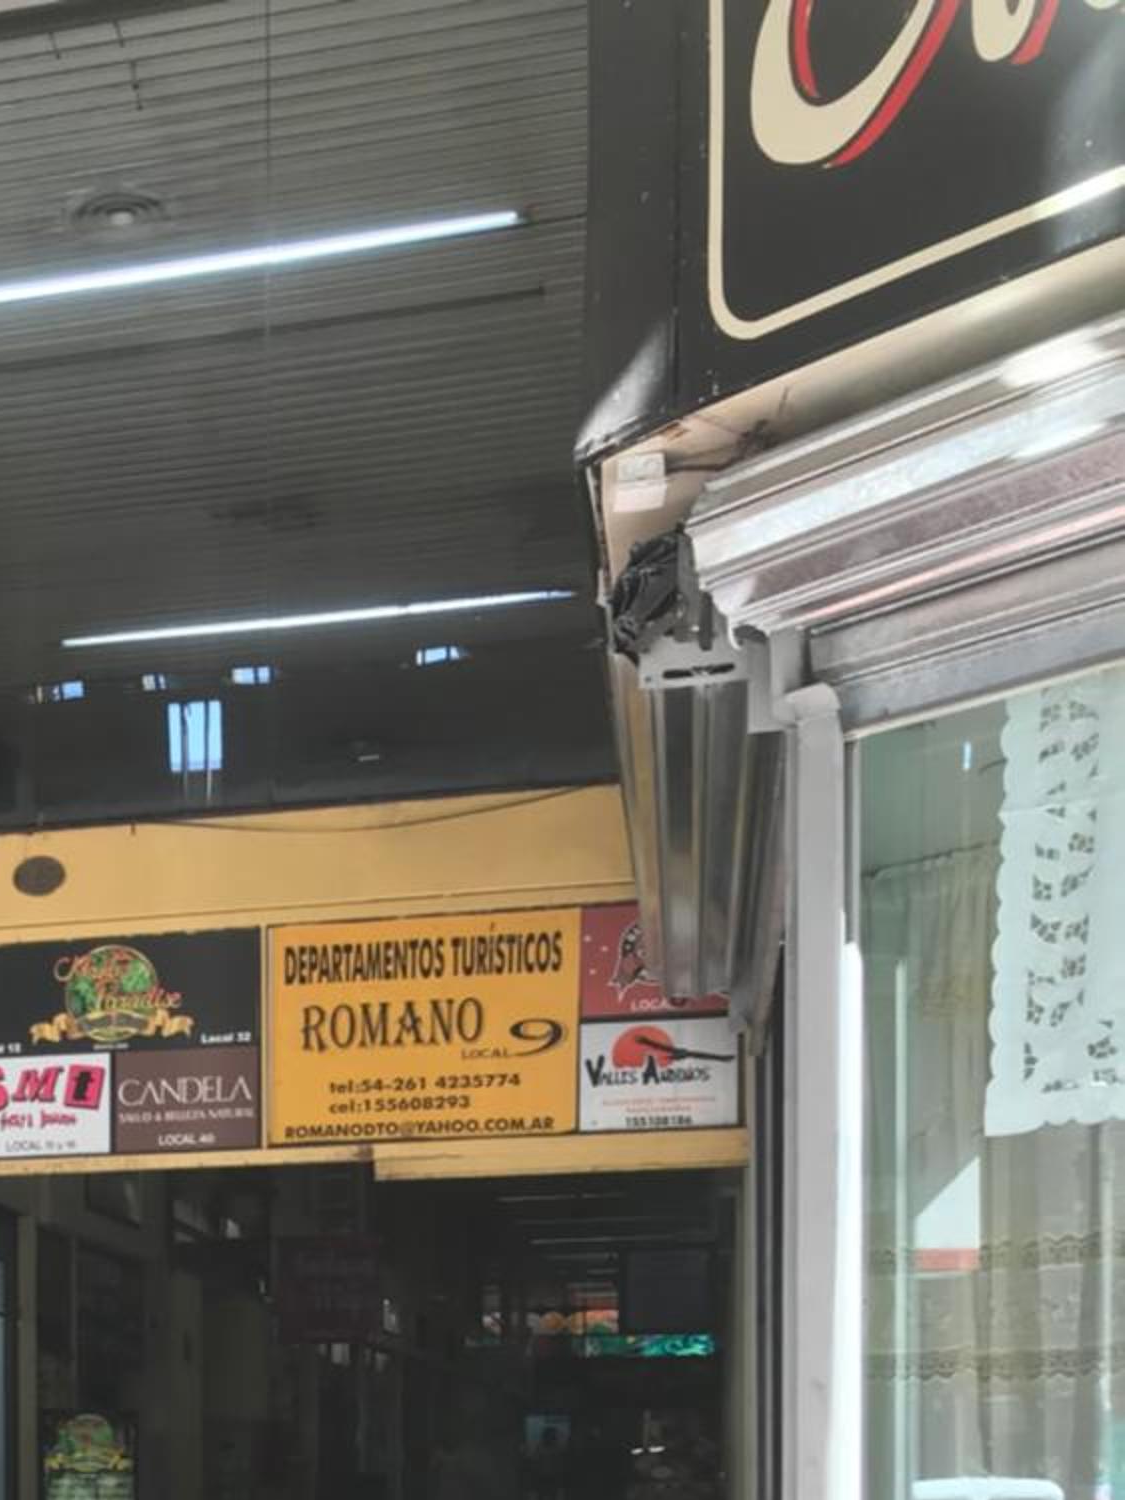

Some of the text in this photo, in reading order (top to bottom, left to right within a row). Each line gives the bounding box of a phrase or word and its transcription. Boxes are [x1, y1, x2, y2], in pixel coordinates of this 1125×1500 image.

[283, 937, 446, 987] DEPARTAMENTOS
[301, 996, 484, 1052] ROMANO
[460, 1017, 566, 1061] LOCAL 9
[117, 1075, 253, 1107] CANDELA
[328, 1073, 521, 1095] tel:54-261 4235774
[157, 1133, 197, 1147] LOCAL
[284, 1116, 556, 1139] ROMANODTO@YAHOO.COM.AR
